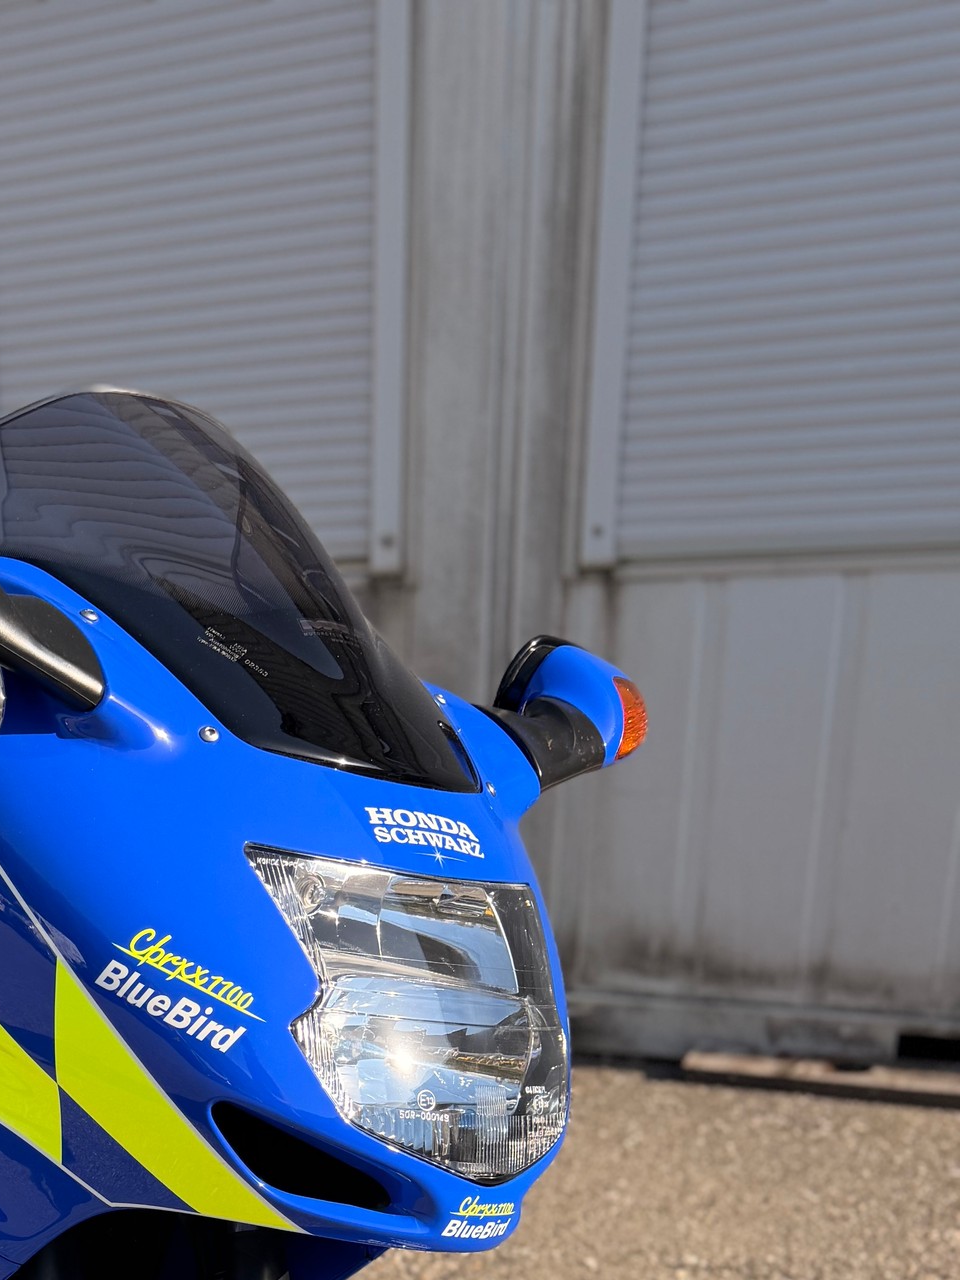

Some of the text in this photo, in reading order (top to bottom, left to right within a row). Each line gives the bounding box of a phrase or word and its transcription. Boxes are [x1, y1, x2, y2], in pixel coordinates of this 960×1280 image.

[364, 806, 480, 843] HONDA
[373, 826, 485, 859] SCHWARZ
[94, 959, 247, 1053] BlueBird
[441, 1217, 512, 1239] BlueBird
